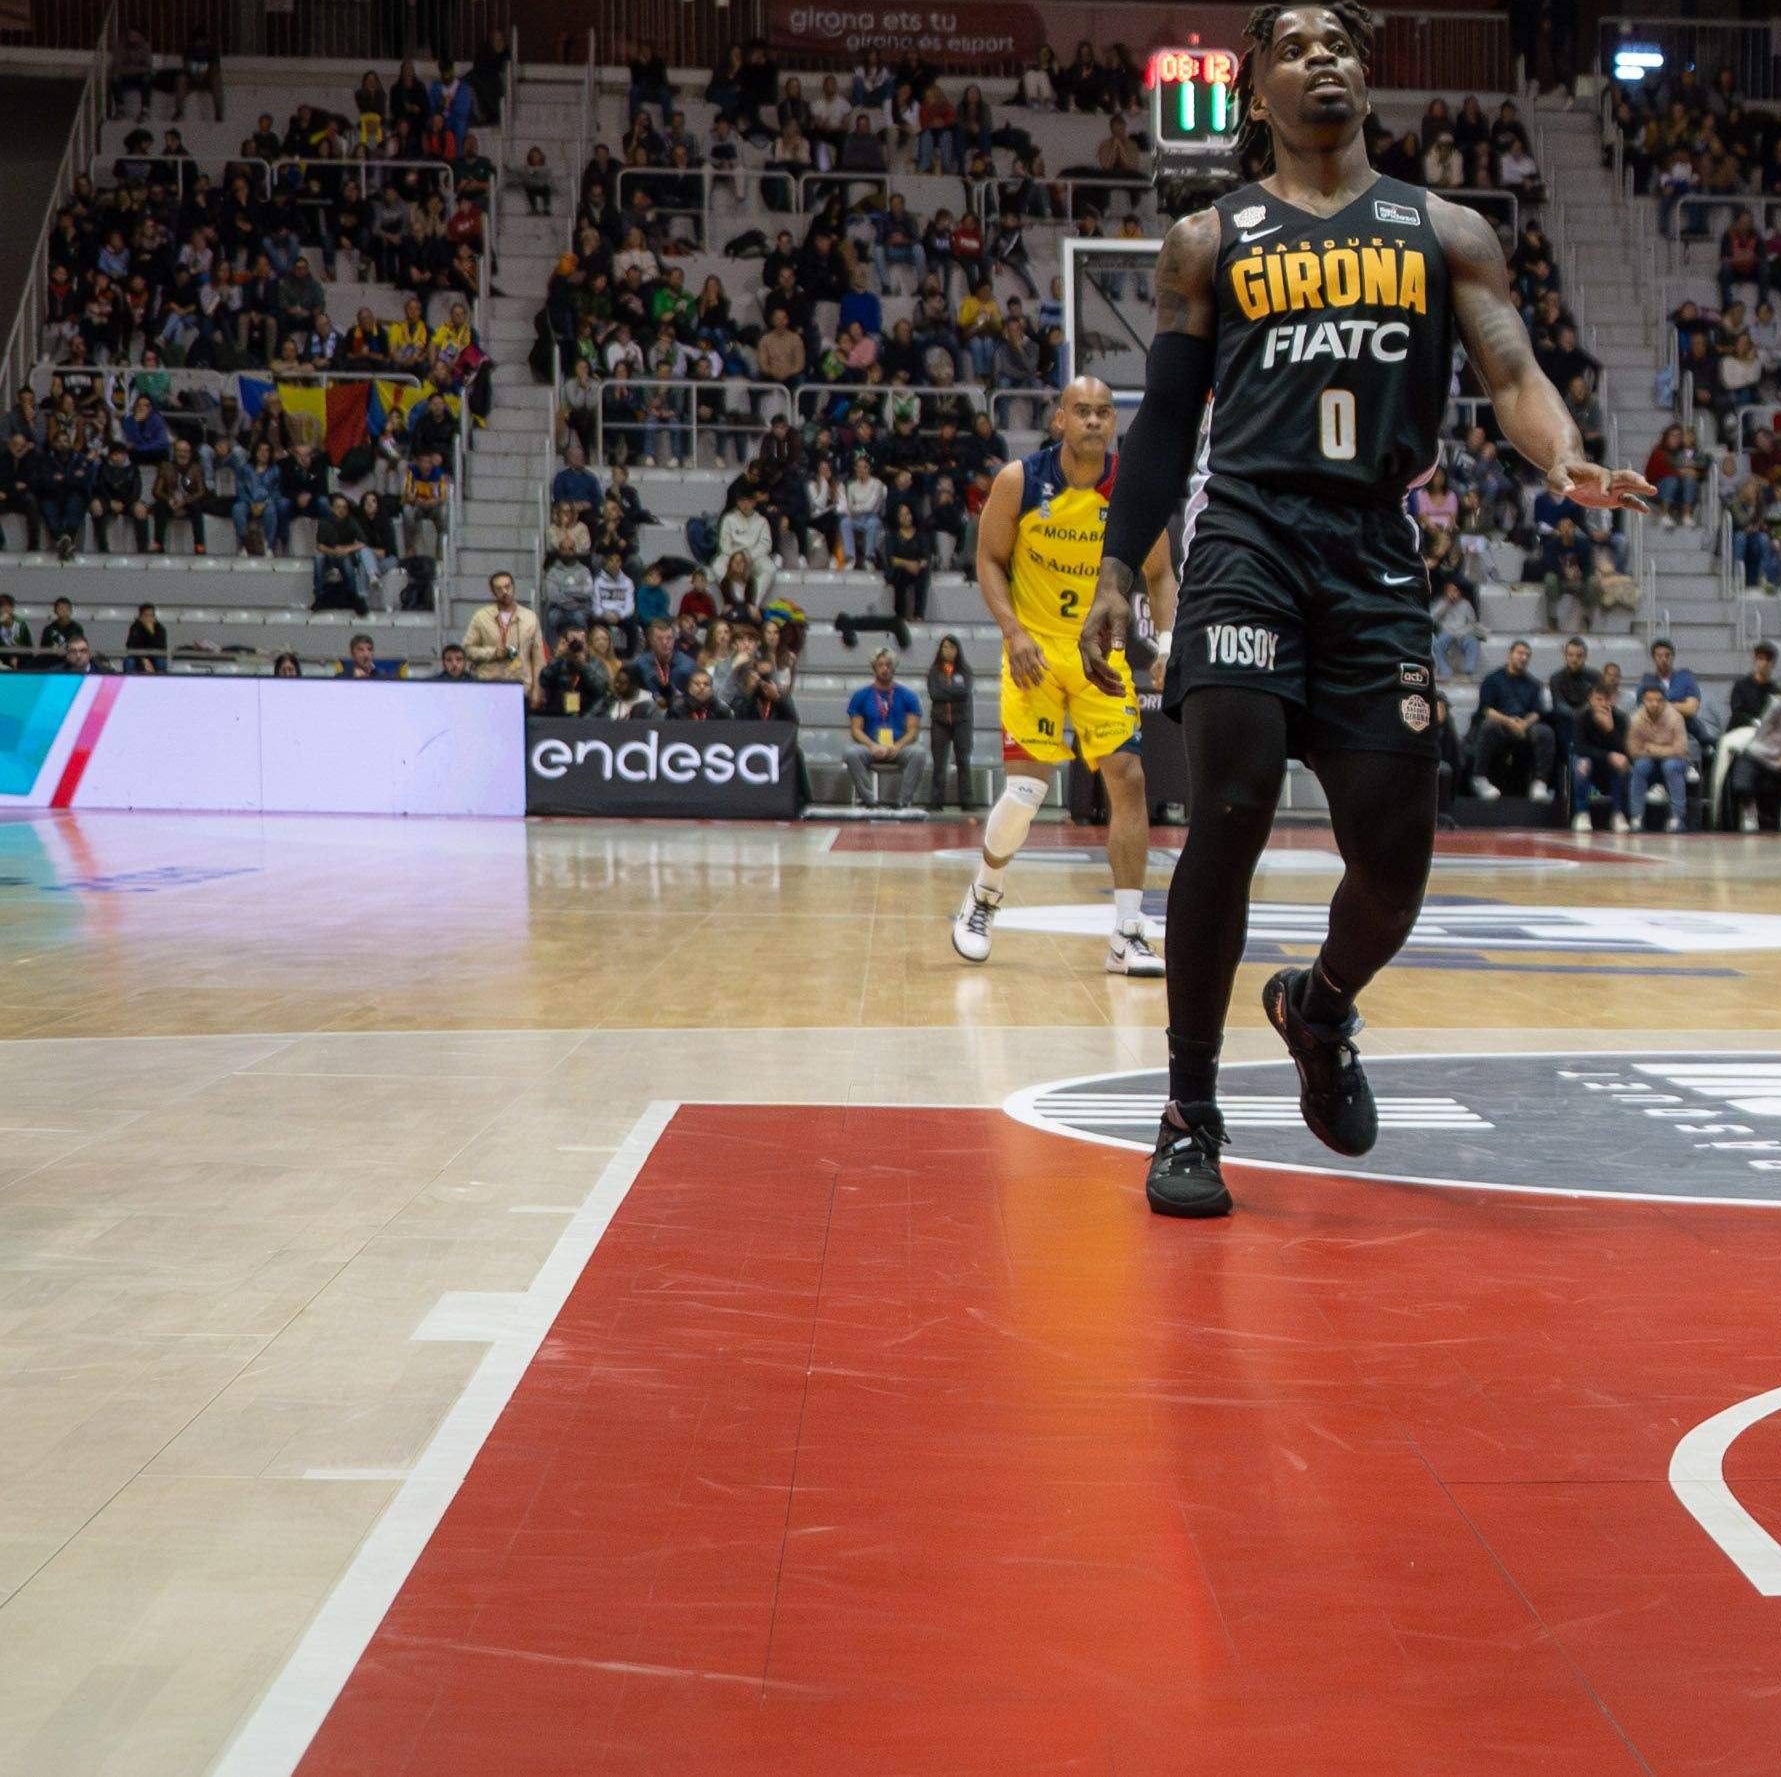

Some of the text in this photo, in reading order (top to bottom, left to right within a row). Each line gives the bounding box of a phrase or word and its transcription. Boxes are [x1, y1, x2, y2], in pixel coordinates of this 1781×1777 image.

[789, 6, 958, 36] girona ets tu
[1179, 79, 1227, 132] 11
[1251, 237, 1407, 256] BASQUET
[1230, 247, 1427, 321] GIRONA
[1262, 319, 1410, 370] FIATC
[1320, 388, 1357, 460] 0
[1059, 589, 1080, 619] 2
[1206, 624, 1280, 672] YOSOY
[531, 730, 779, 785] endesa
